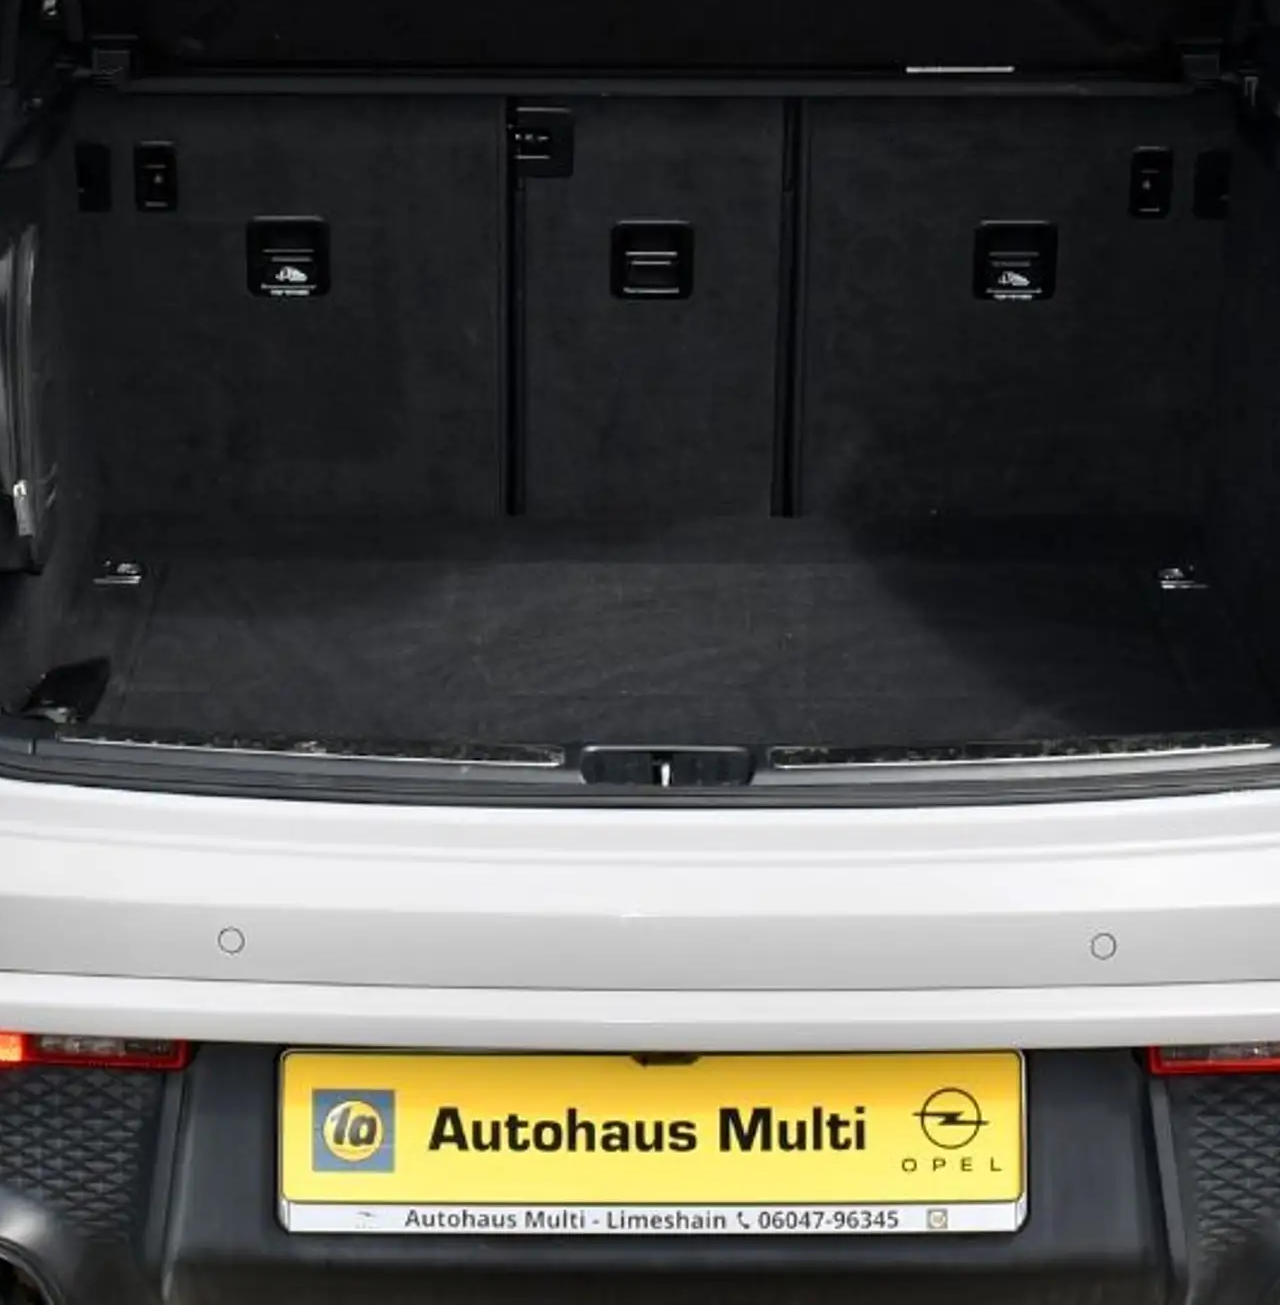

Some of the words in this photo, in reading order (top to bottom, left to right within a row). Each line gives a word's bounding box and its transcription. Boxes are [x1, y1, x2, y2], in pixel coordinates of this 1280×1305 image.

[330, 1106, 378, 1147] 1a
[427, 1106, 698, 1153] Autohaus
[718, 1105, 867, 1153] Multi
[901, 1156, 1003, 1172] OPEL
[404, 1208, 518, 1229] Autohaus
[524, 1208, 586, 1229] Multi
[606, 1208, 727, 1229] Limeshain
[757, 1209, 900, 1230] 06047-96345
